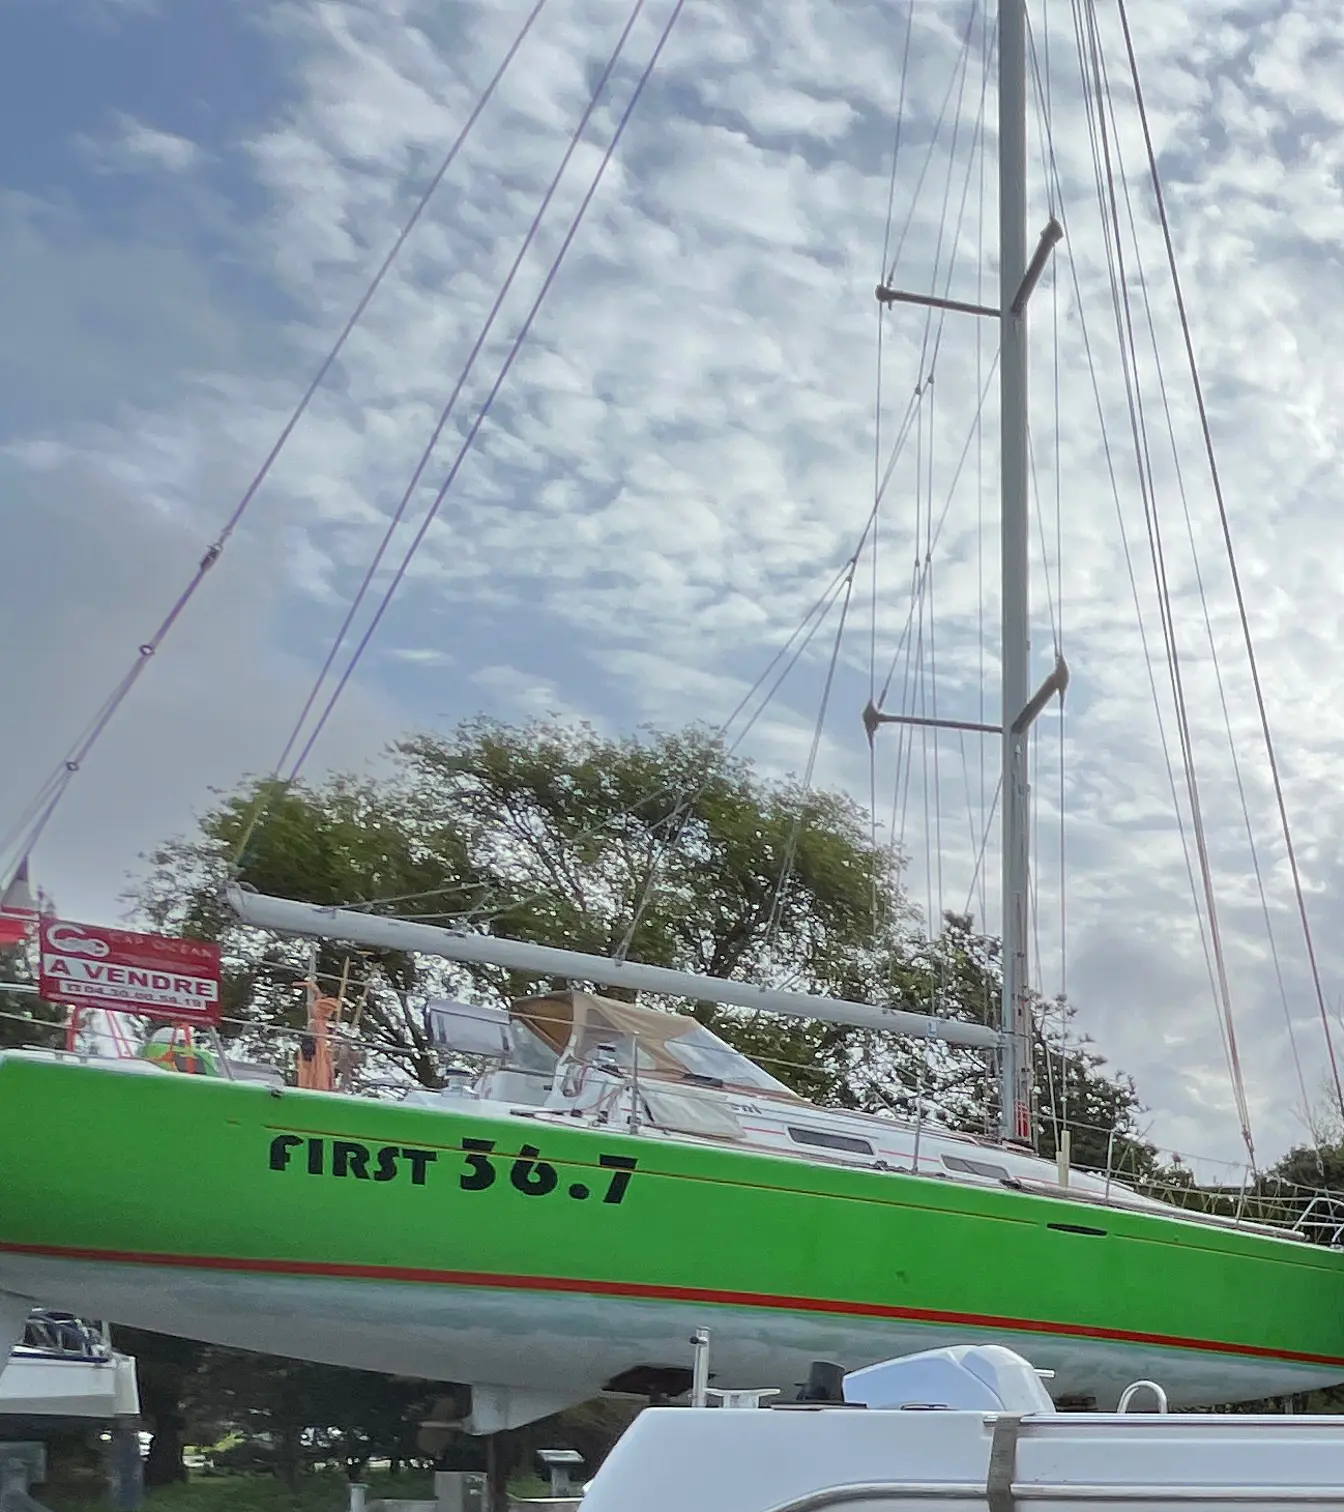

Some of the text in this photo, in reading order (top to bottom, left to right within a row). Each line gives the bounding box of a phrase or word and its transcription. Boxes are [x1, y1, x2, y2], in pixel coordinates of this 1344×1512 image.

[49, 958, 73, 977] A
[82, 962, 214, 998] VENDRE
[268, 1134, 639, 1205] FIRST 36.7
